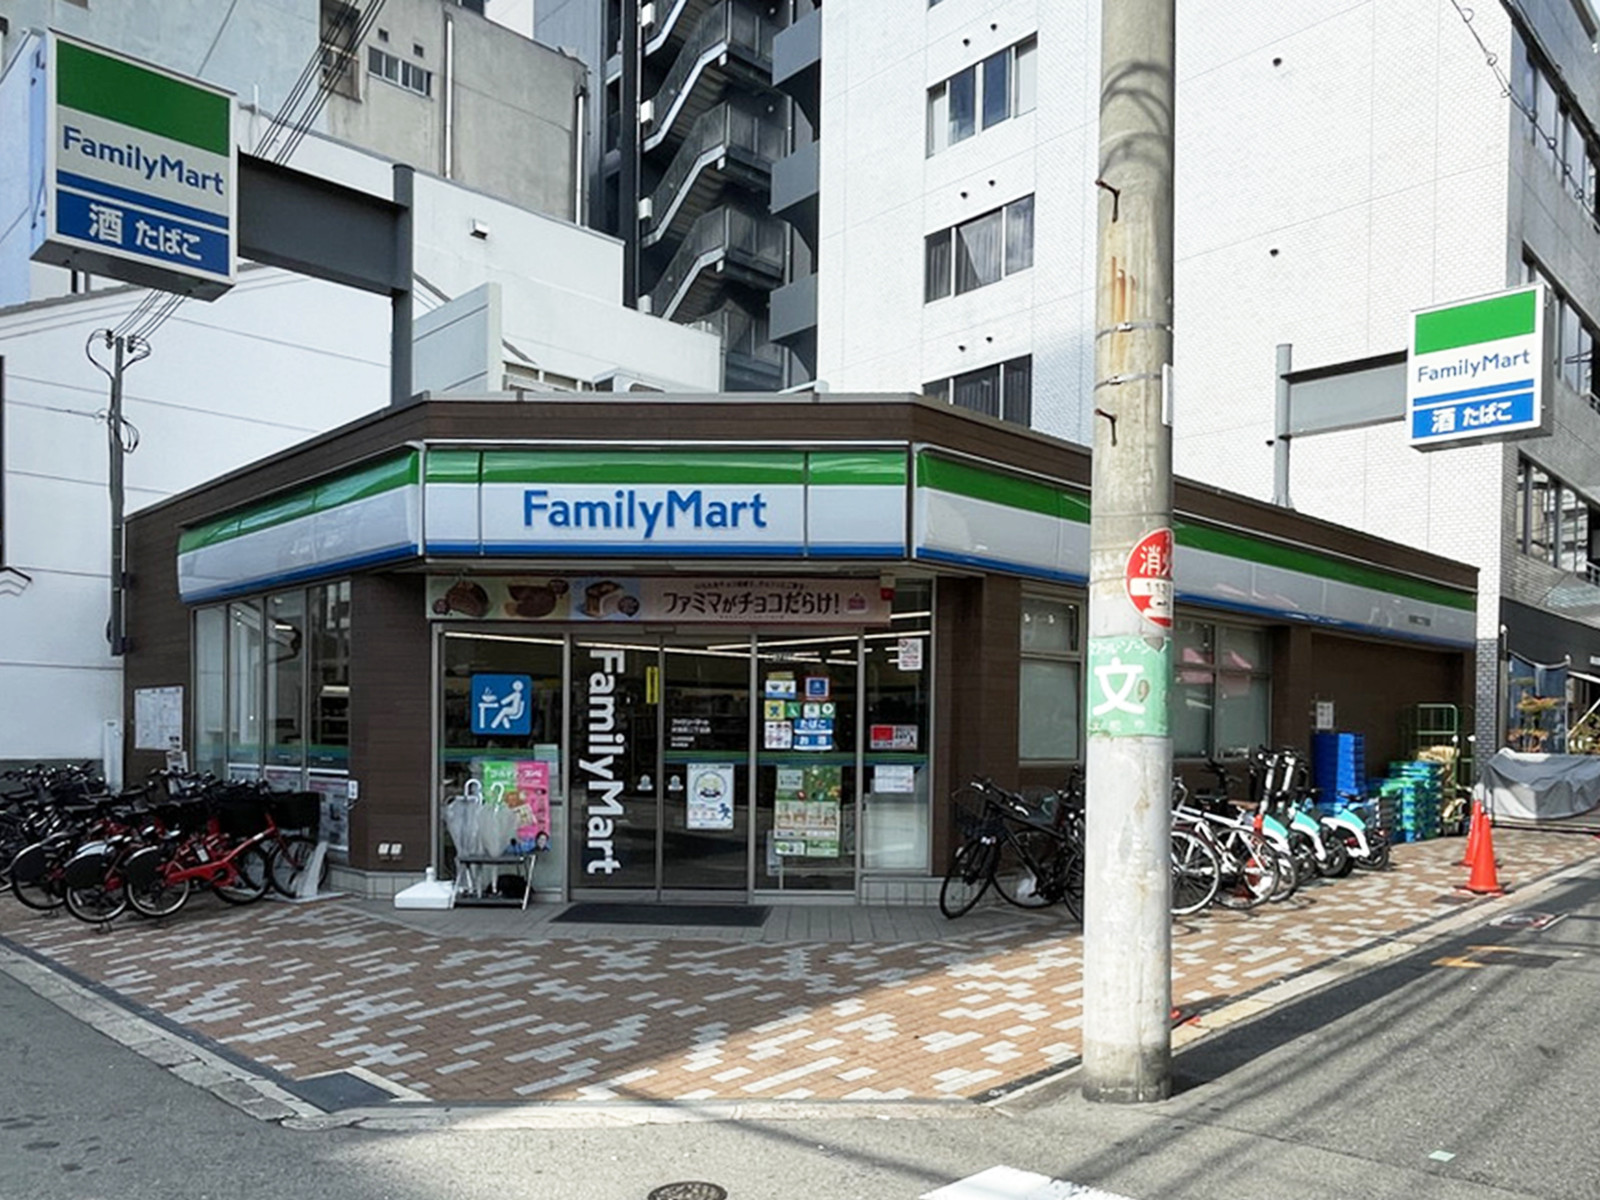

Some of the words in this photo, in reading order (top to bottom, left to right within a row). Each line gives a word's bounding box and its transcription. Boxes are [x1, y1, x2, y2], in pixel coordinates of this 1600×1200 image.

[62, 125, 224, 195] FamilyMart
[89, 203, 123, 245] 酒
[135, 219, 202, 260] たばこ
[1417, 349, 1531, 383] FamilyMart
[1431, 407, 1456, 433] 酒
[1462, 401, 1513, 427] たばこ
[523, 489, 767, 539] FamilyMart
[1092, 656, 1146, 716] 文
[578, 649, 625, 874] FamilyMart
